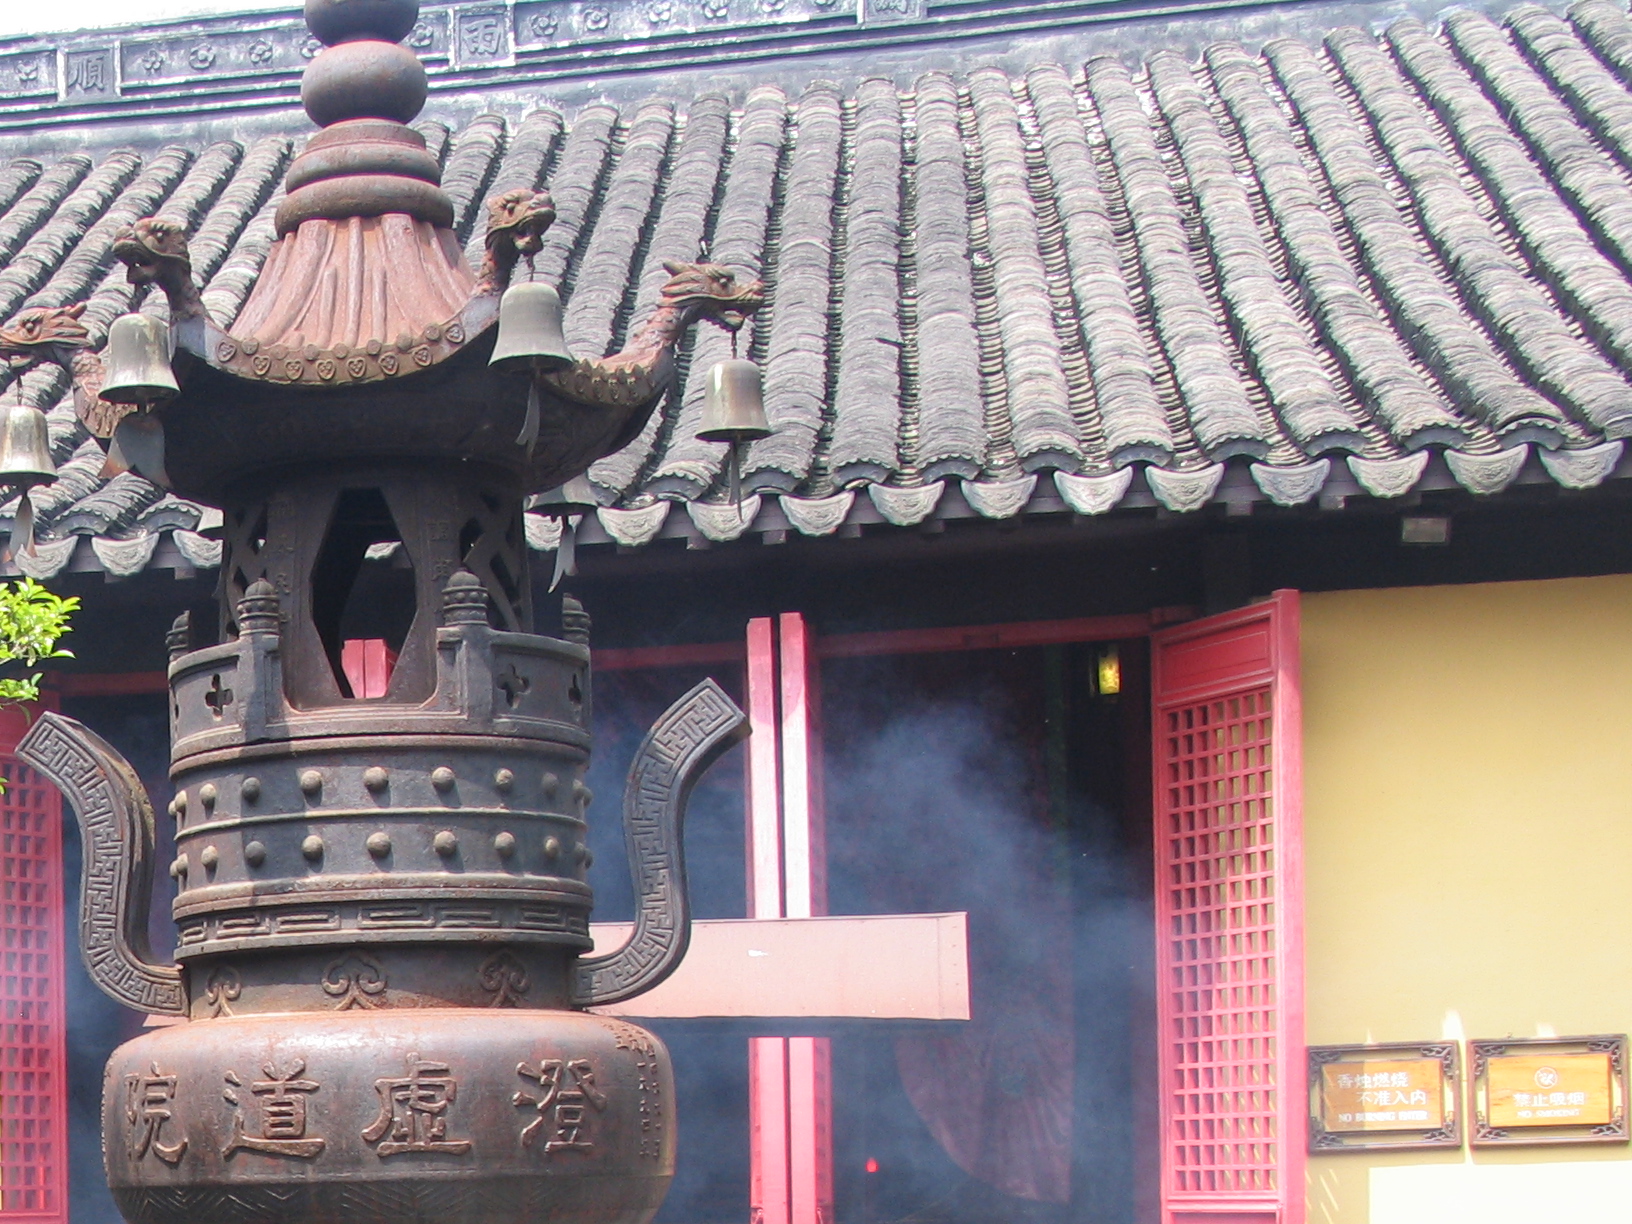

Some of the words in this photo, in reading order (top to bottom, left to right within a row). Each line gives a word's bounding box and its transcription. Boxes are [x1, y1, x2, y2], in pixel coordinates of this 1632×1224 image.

[461, 19, 503, 56] 雨
[69, 55, 108, 92] 順
[1337, 1071, 1409, 1089] 香烛燃烧
[1356, 1089, 1427, 1107] 不准入内
[1512, 1091, 1585, 1108] 禁止吸烟
[1338, 1112, 1352, 1123] NO
[1517, 1110, 1533, 1119] NO
